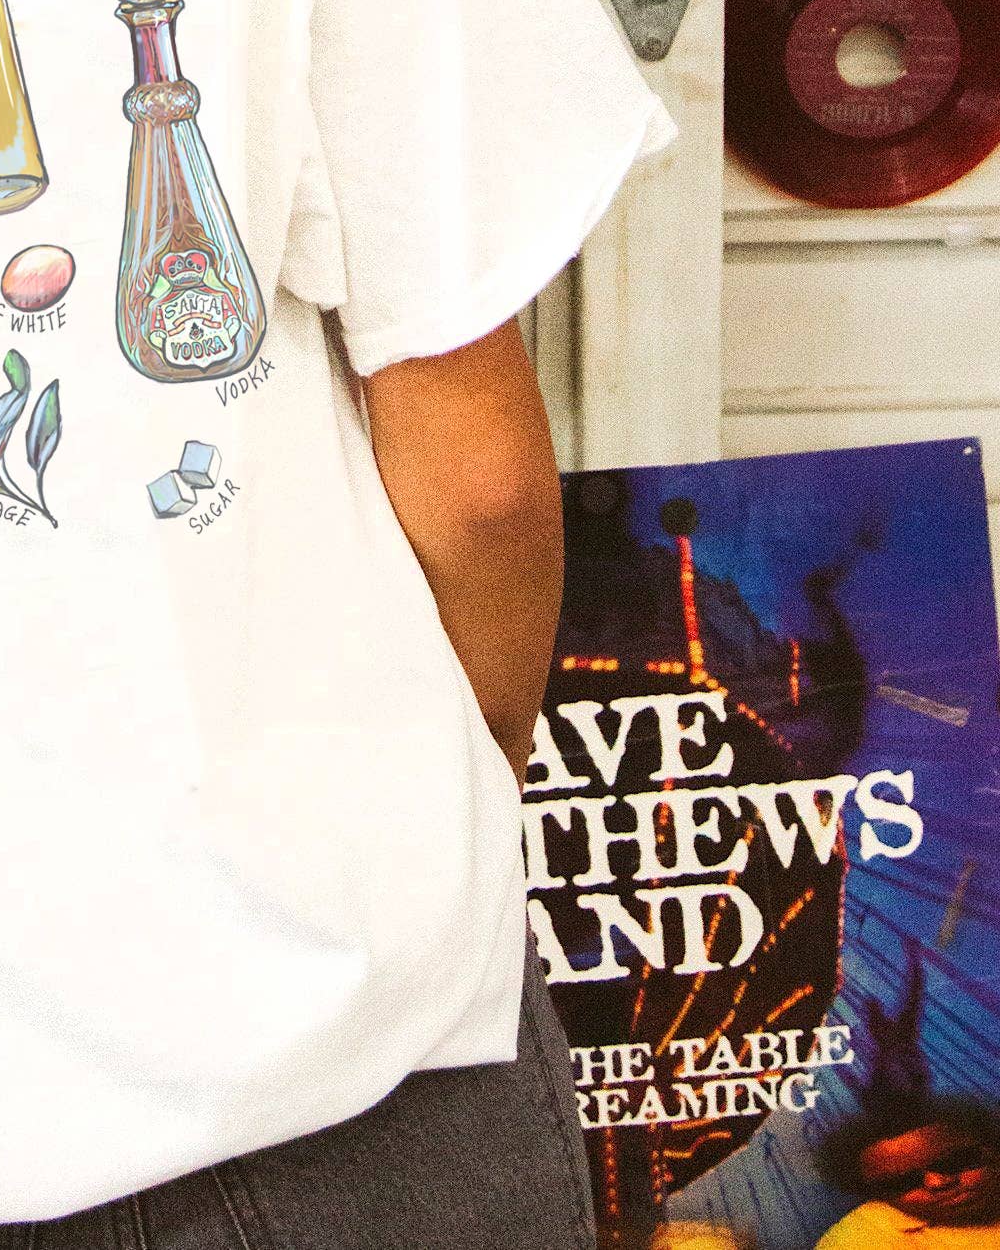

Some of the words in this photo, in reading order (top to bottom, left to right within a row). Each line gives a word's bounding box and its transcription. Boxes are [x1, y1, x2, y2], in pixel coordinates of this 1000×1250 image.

[10, 304, 69, 334] WHITE
[165, 294, 222, 320] SANTA
[169, 335, 229, 361] VODKA
[215, 356, 277, 407] VODKA
[188, 479, 241, 535] SUGAR
[668, 1024, 856, 1080] TABLE
